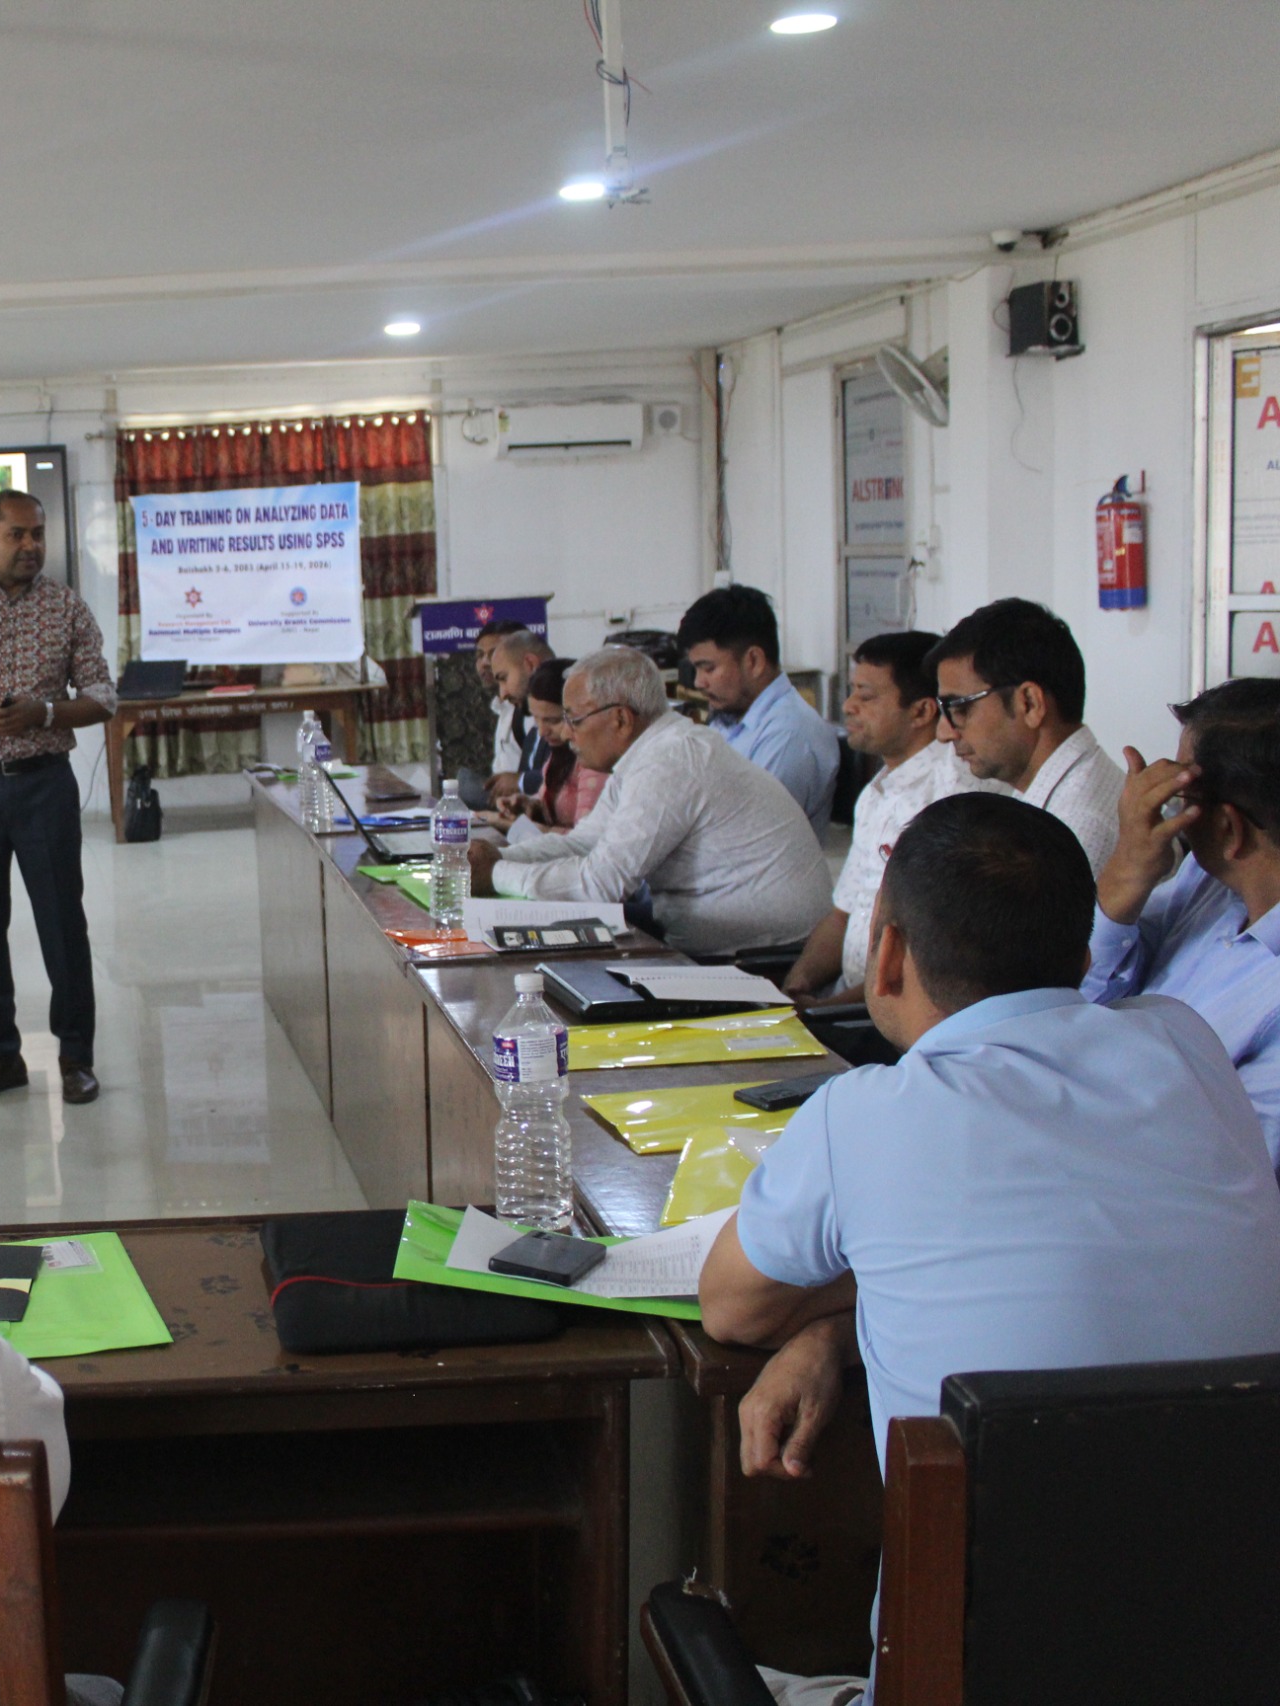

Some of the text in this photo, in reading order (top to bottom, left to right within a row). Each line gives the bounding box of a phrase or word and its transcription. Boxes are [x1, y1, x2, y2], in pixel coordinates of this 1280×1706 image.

[180, 507, 232, 526] TRAINING
[236, 506, 251, 524] ON
[255, 504, 316, 523] ANALYZING
[320, 502, 349, 520] DATA
[151, 531, 345, 555] AND WRITING RESULTS USING SPSS
[248, 618, 282, 627] University
[309, 616, 352, 625] Commission
